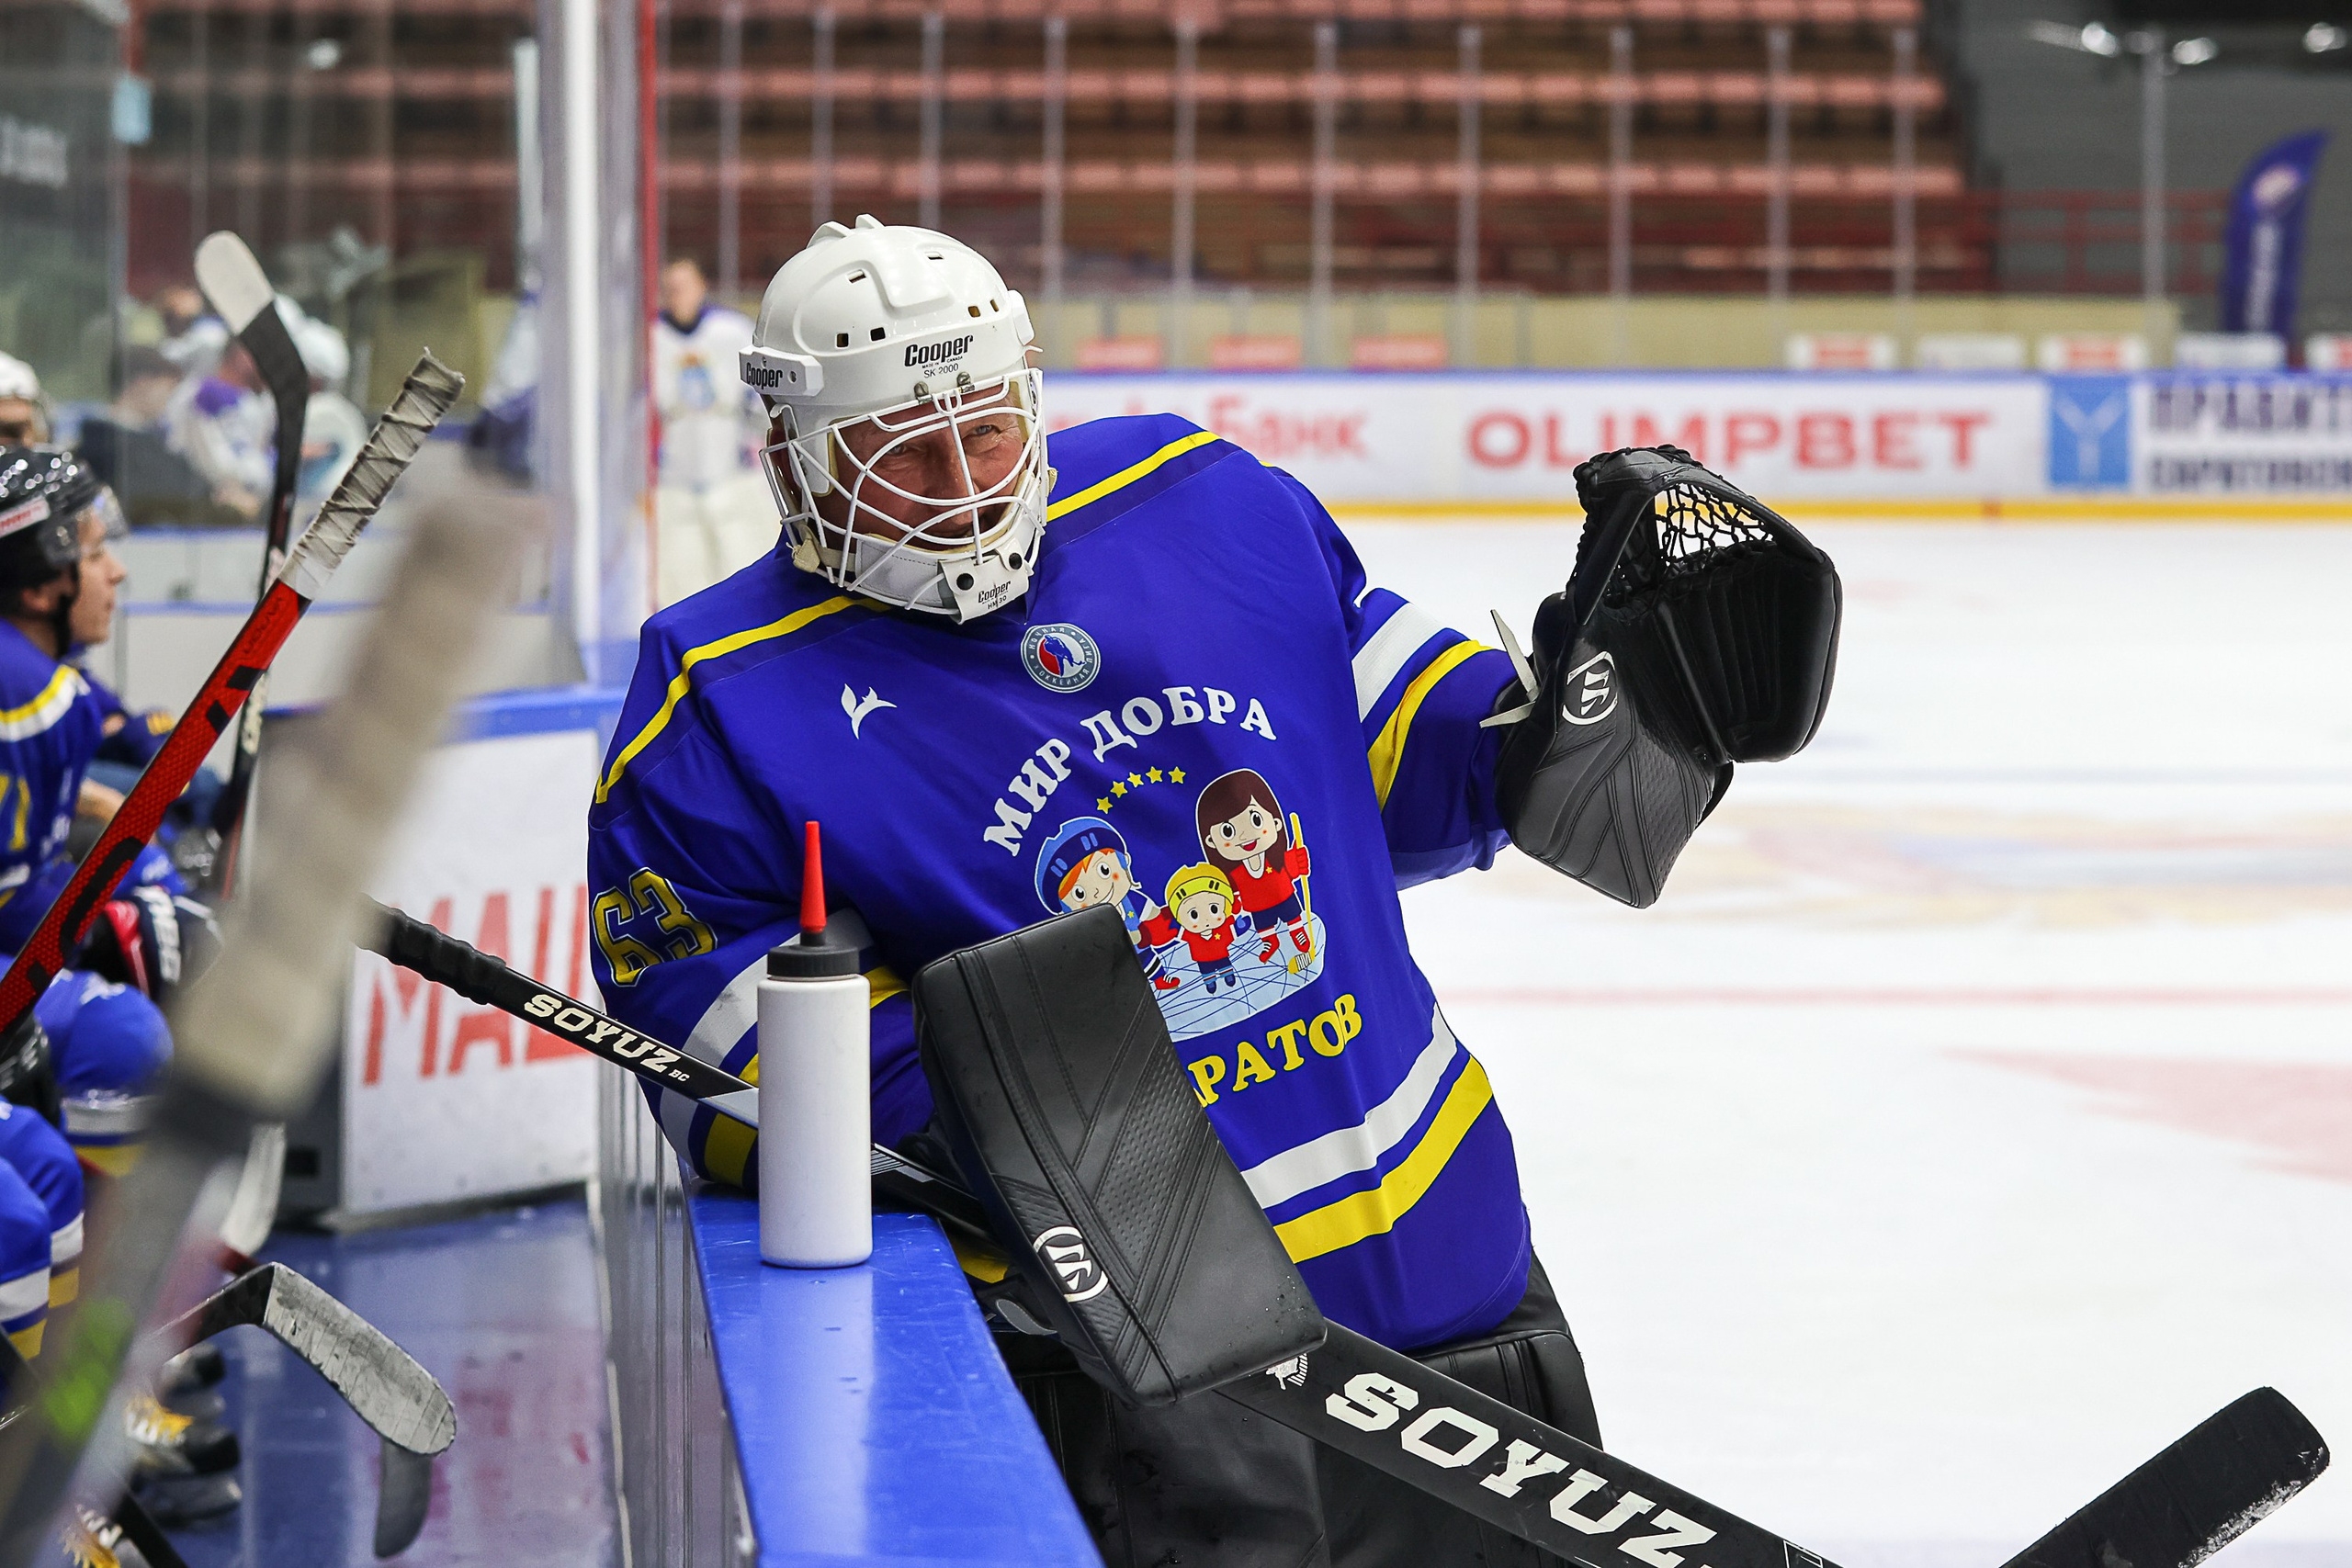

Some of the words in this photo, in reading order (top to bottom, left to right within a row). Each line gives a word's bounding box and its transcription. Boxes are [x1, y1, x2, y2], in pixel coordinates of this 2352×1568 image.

[746, 362, 783, 390] Cooper
[904, 334, 974, 367] Cooper
[923, 368, 936, 378] SK
[938, 363, 959, 375] 2000
[1467, 410, 1994, 472] OLIMPBET
[978, 581, 1012, 604] Cooper
[1028, 626, 1066, 650] НОЧНАЯ
[983, 737, 1071, 856] МИР
[1080, 686, 1277, 762] ДОБРА
[592, 867, 718, 987] 63
[524, 993, 682, 1073] SOYUZ
[668, 1068, 691, 1083] BC
[1187, 993, 1363, 1108] РАТОВ
[1325, 1372, 1717, 1568] SOYUZ
